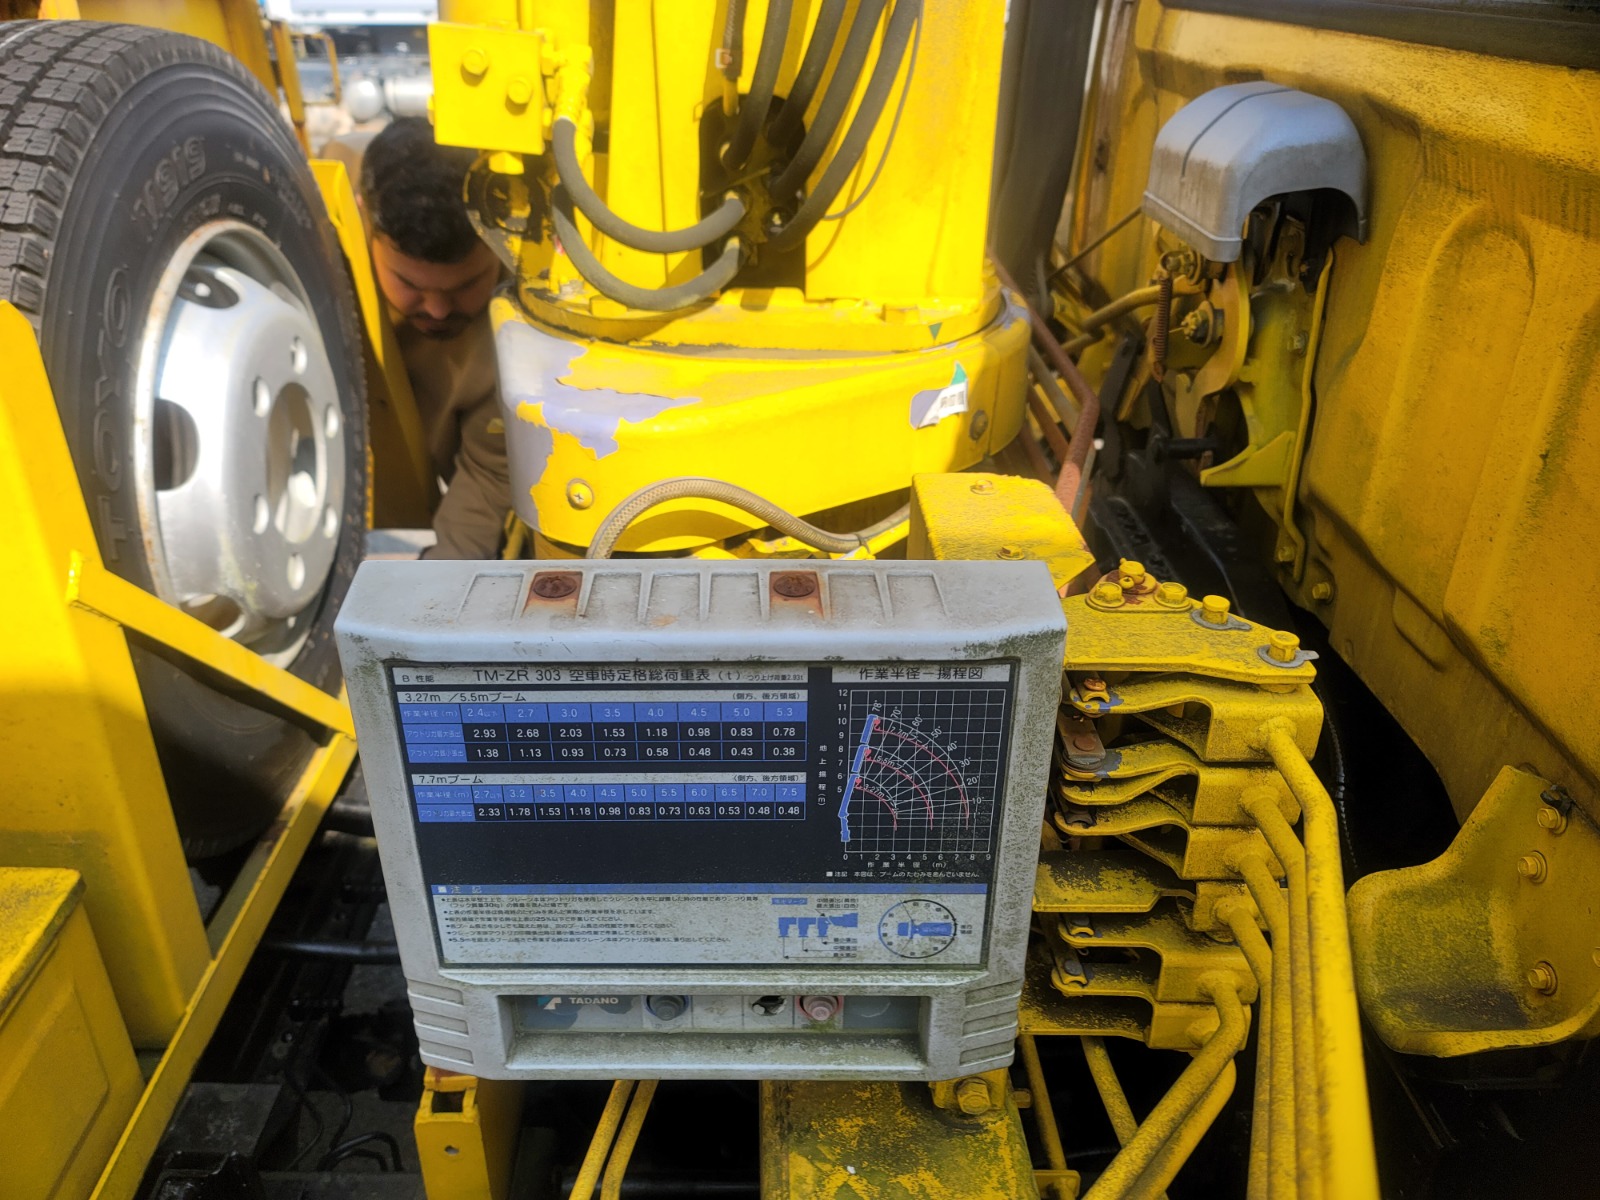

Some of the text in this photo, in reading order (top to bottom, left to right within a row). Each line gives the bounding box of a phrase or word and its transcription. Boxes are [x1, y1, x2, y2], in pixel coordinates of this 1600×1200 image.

[93, 266, 132, 563] TOYO
[401, 674, 435, 683] B 性能
[472, 669, 530, 682] TM-ZR
[535, 670, 562, 682] 303
[404, 692, 441, 703] 3.27m
[838, 689, 848, 697] 12
[647, 707, 664, 717] 4.0
[690, 707, 707, 717] 4.5
[733, 707, 751, 717] 5.0
[776, 707, 793, 717] 5.3
[837, 703, 848, 711] 11
[517, 708, 534, 718] 2.7
[561, 708, 578, 718] 3.0
[604, 708, 621, 718] 3.5
[837, 717, 848, 725] 10
[473, 728, 497, 738] 2.93
[516, 728, 540, 738] 2.68
[559, 728, 583, 738] 2.03
[603, 728, 626, 738] 1.53
[646, 727, 668, 737] 1.18
[687, 727, 711, 737] 0.98
[730, 727, 753, 737] 0.83
[772, 727, 796, 737] 0.78
[476, 748, 499, 758] 1.38
[519, 748, 542, 758] 1.13
[561, 748, 584, 757] 0.93
[603, 747, 627, 757] 0.73
[646, 747, 669, 757] 0.58
[688, 747, 711, 757] 0.48
[730, 747, 754, 757] 0.43
[772, 746, 796, 756] 0.38
[418, 775, 484, 784] 7.7mブーム
[509, 789, 526, 798] 3.2
[540, 788, 556, 798] 3.5
[570, 788, 587, 798] 4.0
[600, 788, 617, 797] 4.5
[631, 788, 647, 797] 5.0
[661, 788, 678, 797] 5.5
[691, 788, 708, 797] 6.0
[721, 787, 738, 797] 6.5
[751, 787, 768, 797] 7.0
[782, 787, 798, 797] 7.5
[478, 807, 501, 817] 2.33
[509, 807, 532, 817] 1.78
[539, 807, 562, 817] 1.53
[569, 806, 591, 817] 1.18
[598, 806, 622, 816] 0.98
[628, 806, 651, 816] 0.83
[658, 806, 681, 816] 0.73
[688, 806, 711, 815] 0.63
[718, 806, 741, 816] 0.53
[748, 806, 771, 816] 0.48
[778, 806, 800, 815] 0.48
[569, 996, 620, 1005] TADANO
